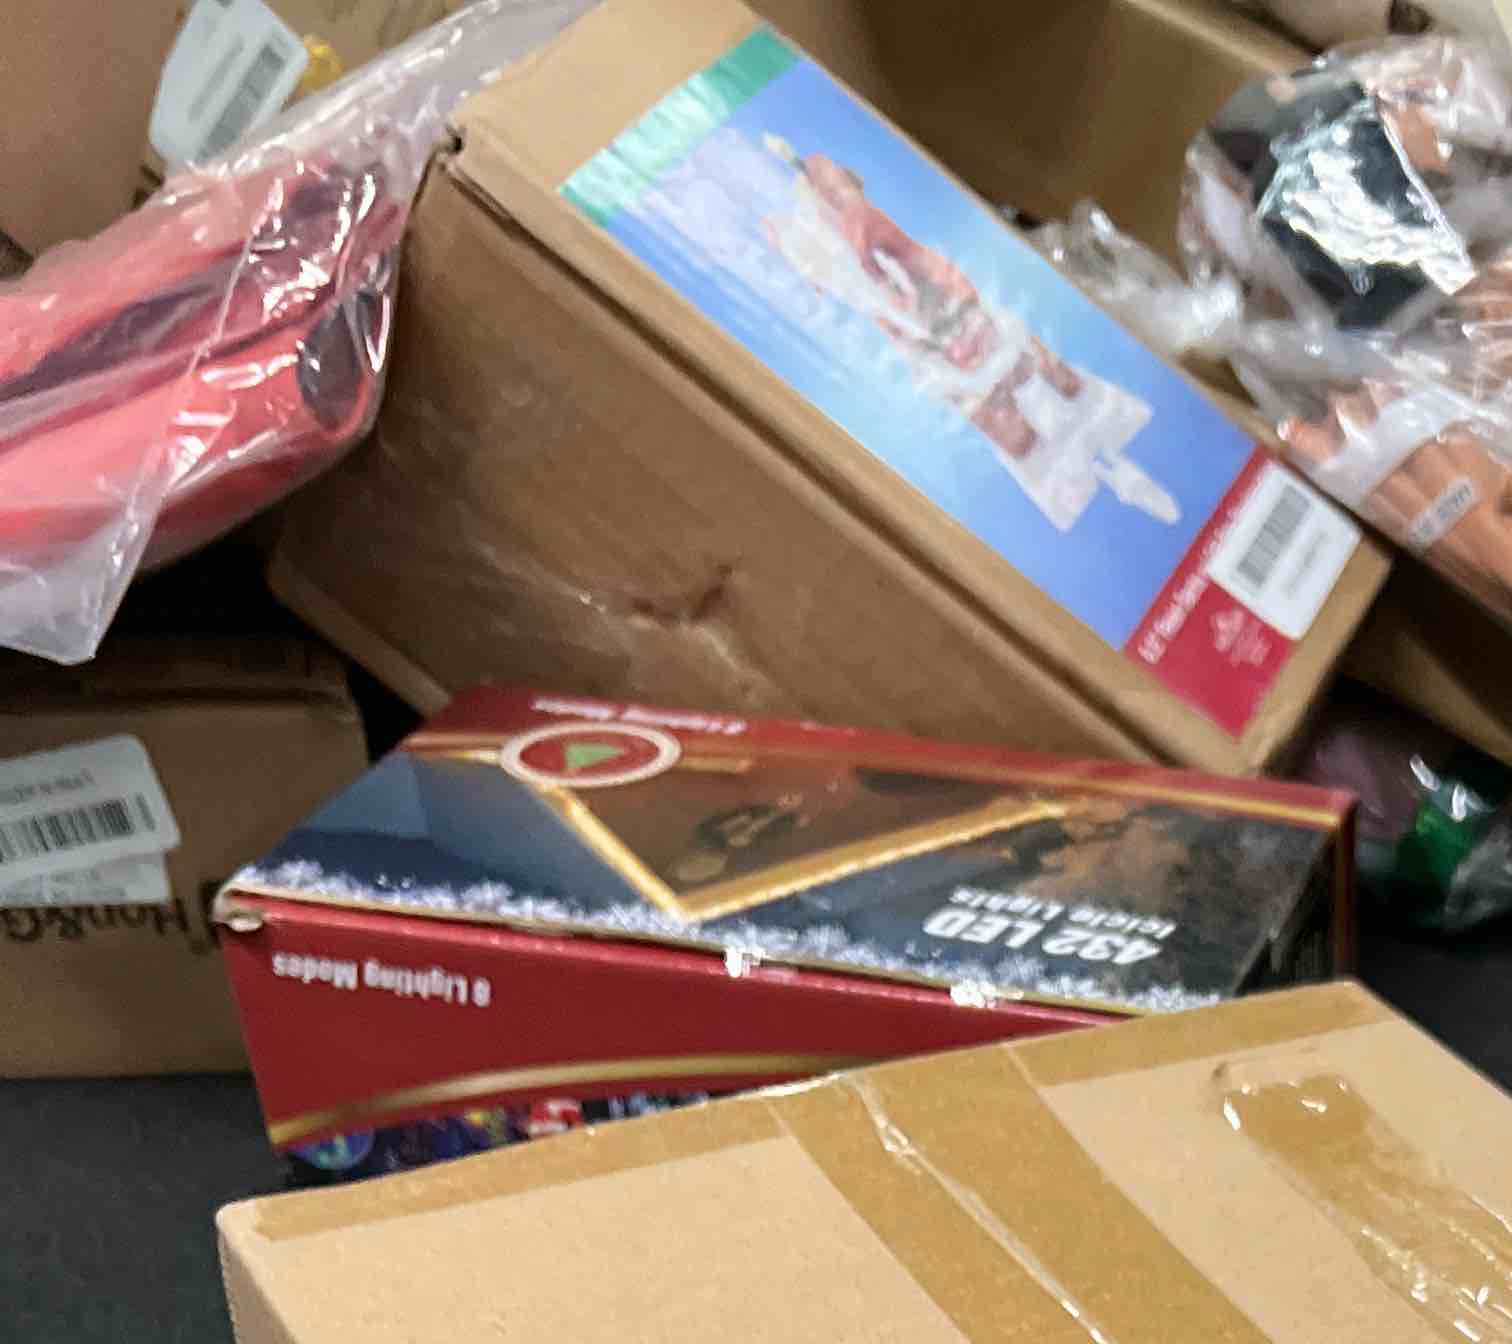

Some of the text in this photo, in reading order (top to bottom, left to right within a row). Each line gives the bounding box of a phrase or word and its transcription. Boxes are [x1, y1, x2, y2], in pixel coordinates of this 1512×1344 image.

[922, 906, 1163, 965] 432 LED
[271, 951, 358, 990] Modes
[363, 957, 468, 1006] Lighting
